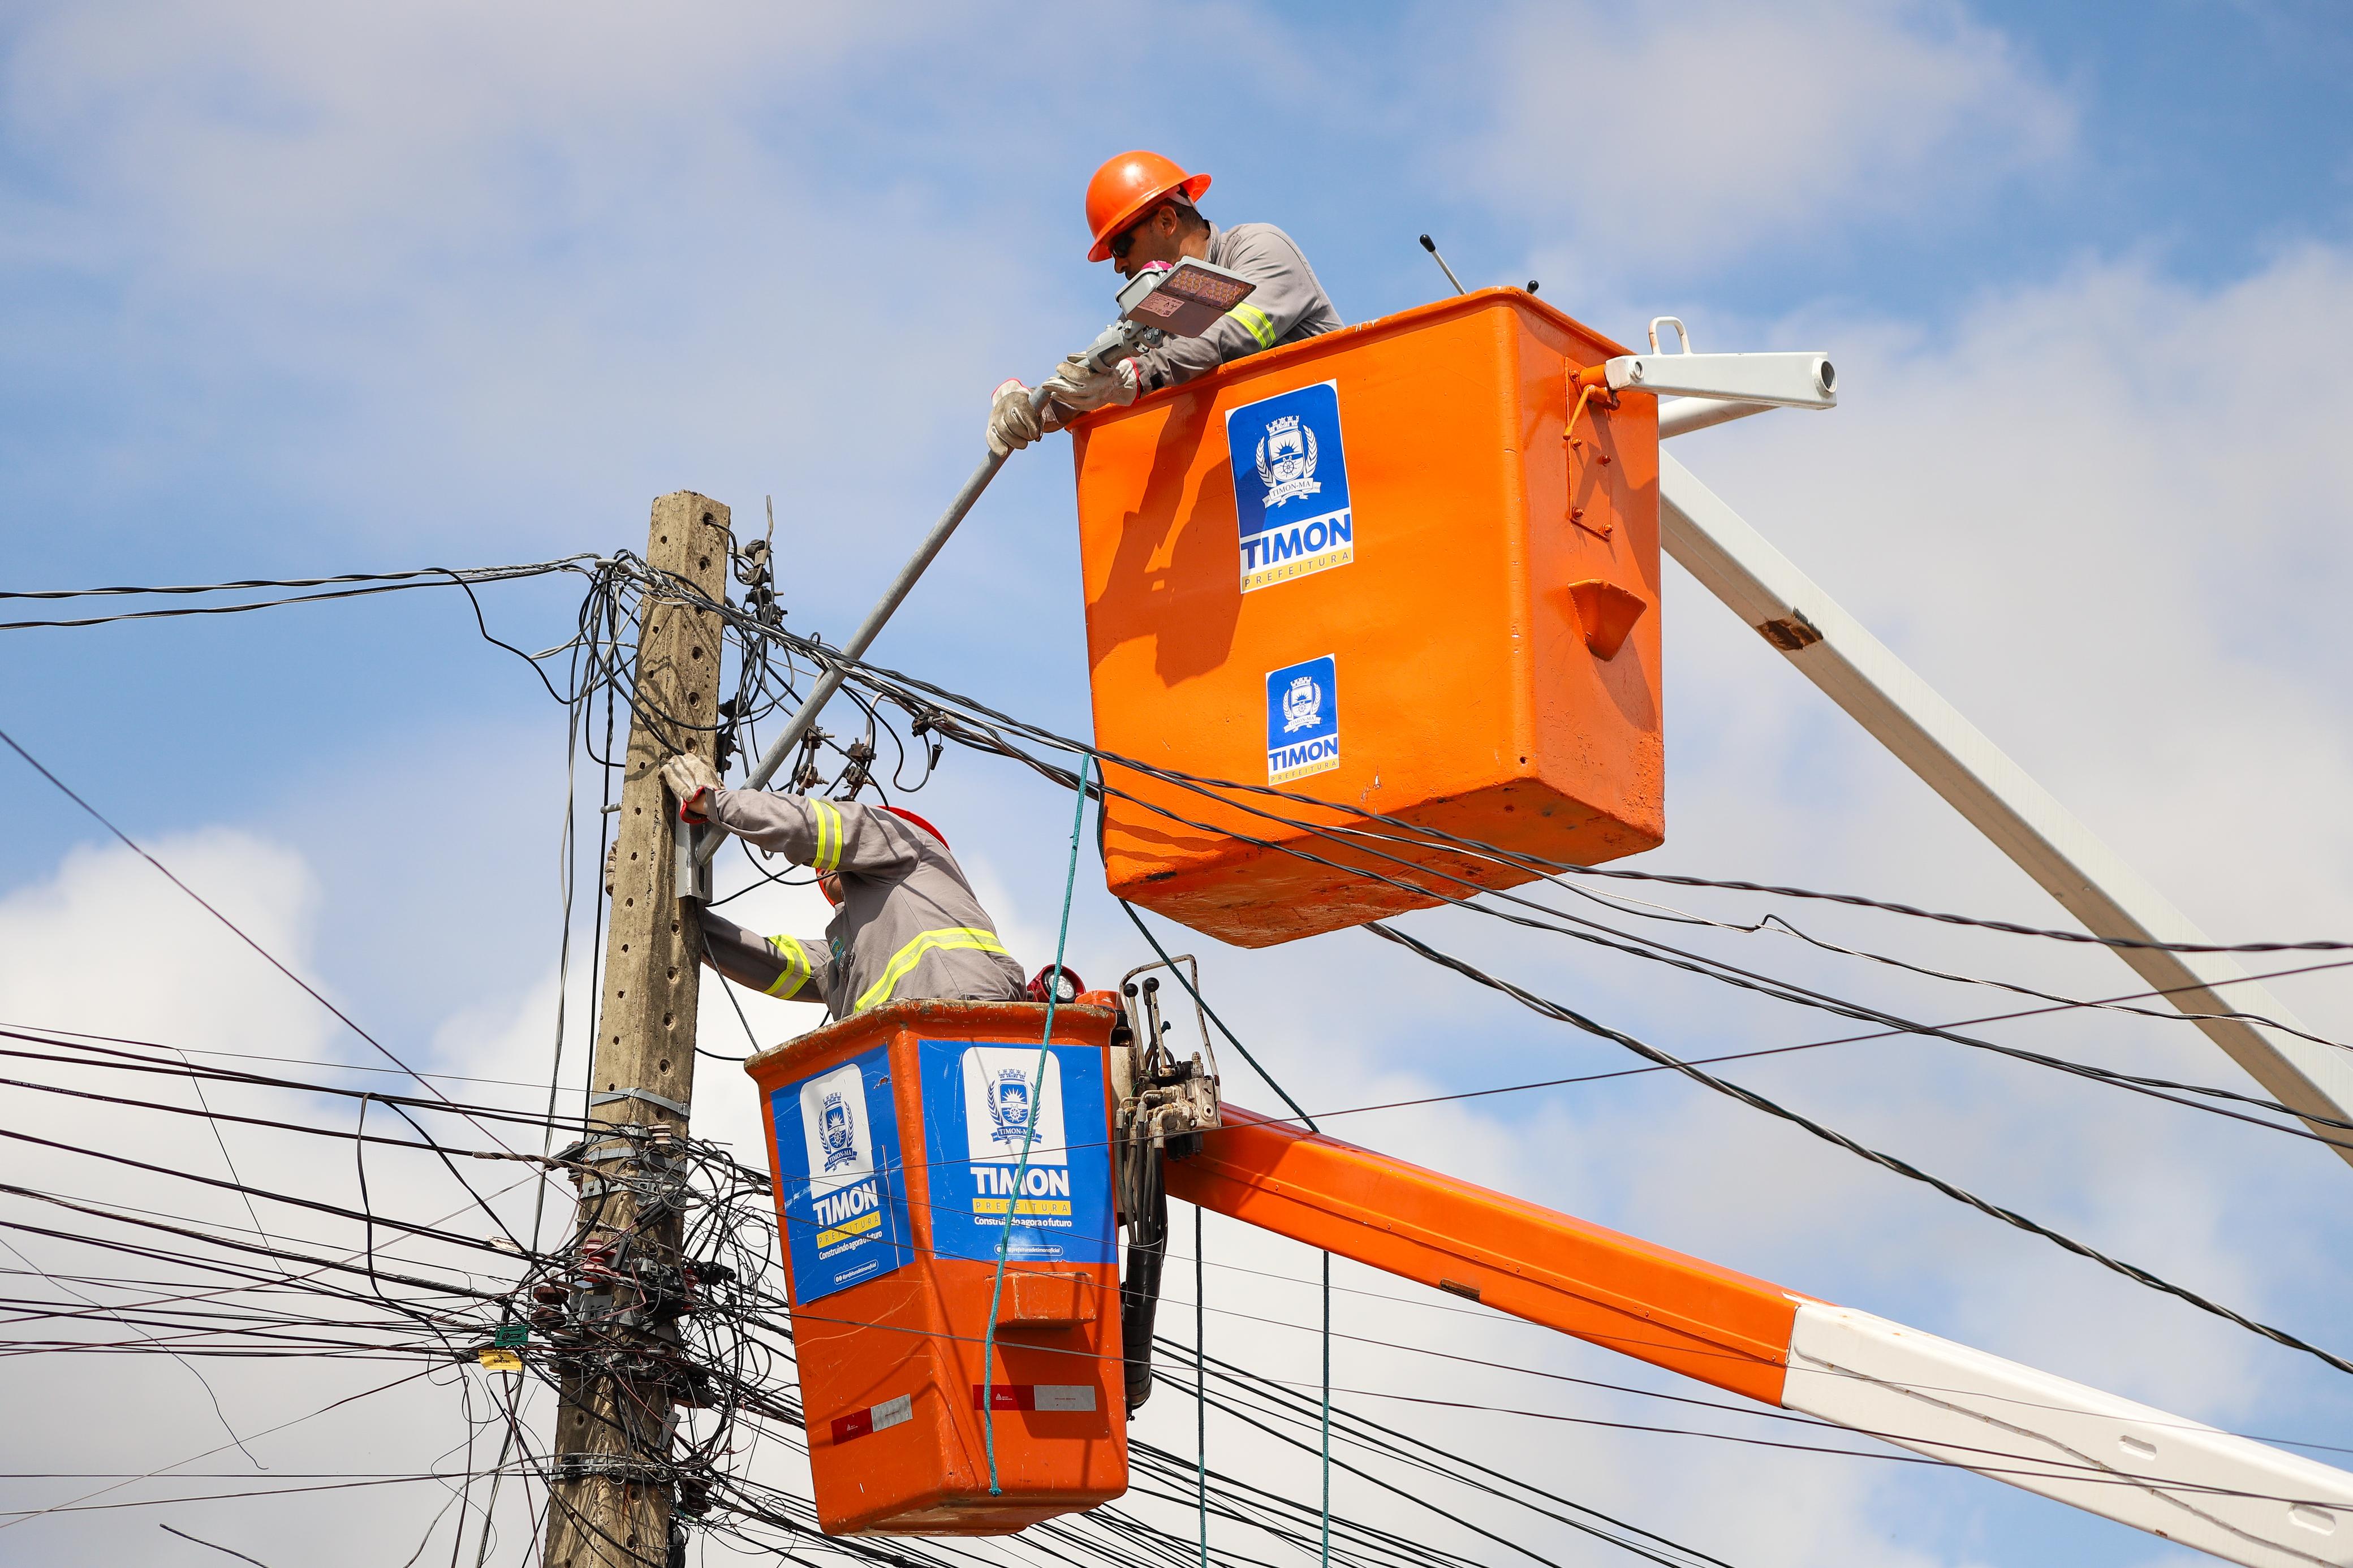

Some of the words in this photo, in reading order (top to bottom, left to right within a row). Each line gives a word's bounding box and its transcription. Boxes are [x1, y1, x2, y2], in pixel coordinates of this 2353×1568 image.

[1272, 481, 1311, 496] TIMON-MA
[1241, 513, 1351, 569] TIMON
[1245, 551, 1348, 588] PREFEITURA
[1269, 737, 1337, 771] TIMON
[1272, 761, 1336, 782] PREFEITURA
[829, 1150, 851, 1163] TIMON-MA
[970, 1167, 1070, 1196] TIMON
[812, 1180, 878, 1229] TIMON
[976, 1202, 1067, 1212] PREFEITURA
[974, 1216, 1019, 1226] Construido
[1020, 1219, 1042, 1228] agora
[1049, 1218, 1072, 1227] futuro
[819, 1243, 849, 1260] Construindo
[849, 1238, 863, 1251] agora
